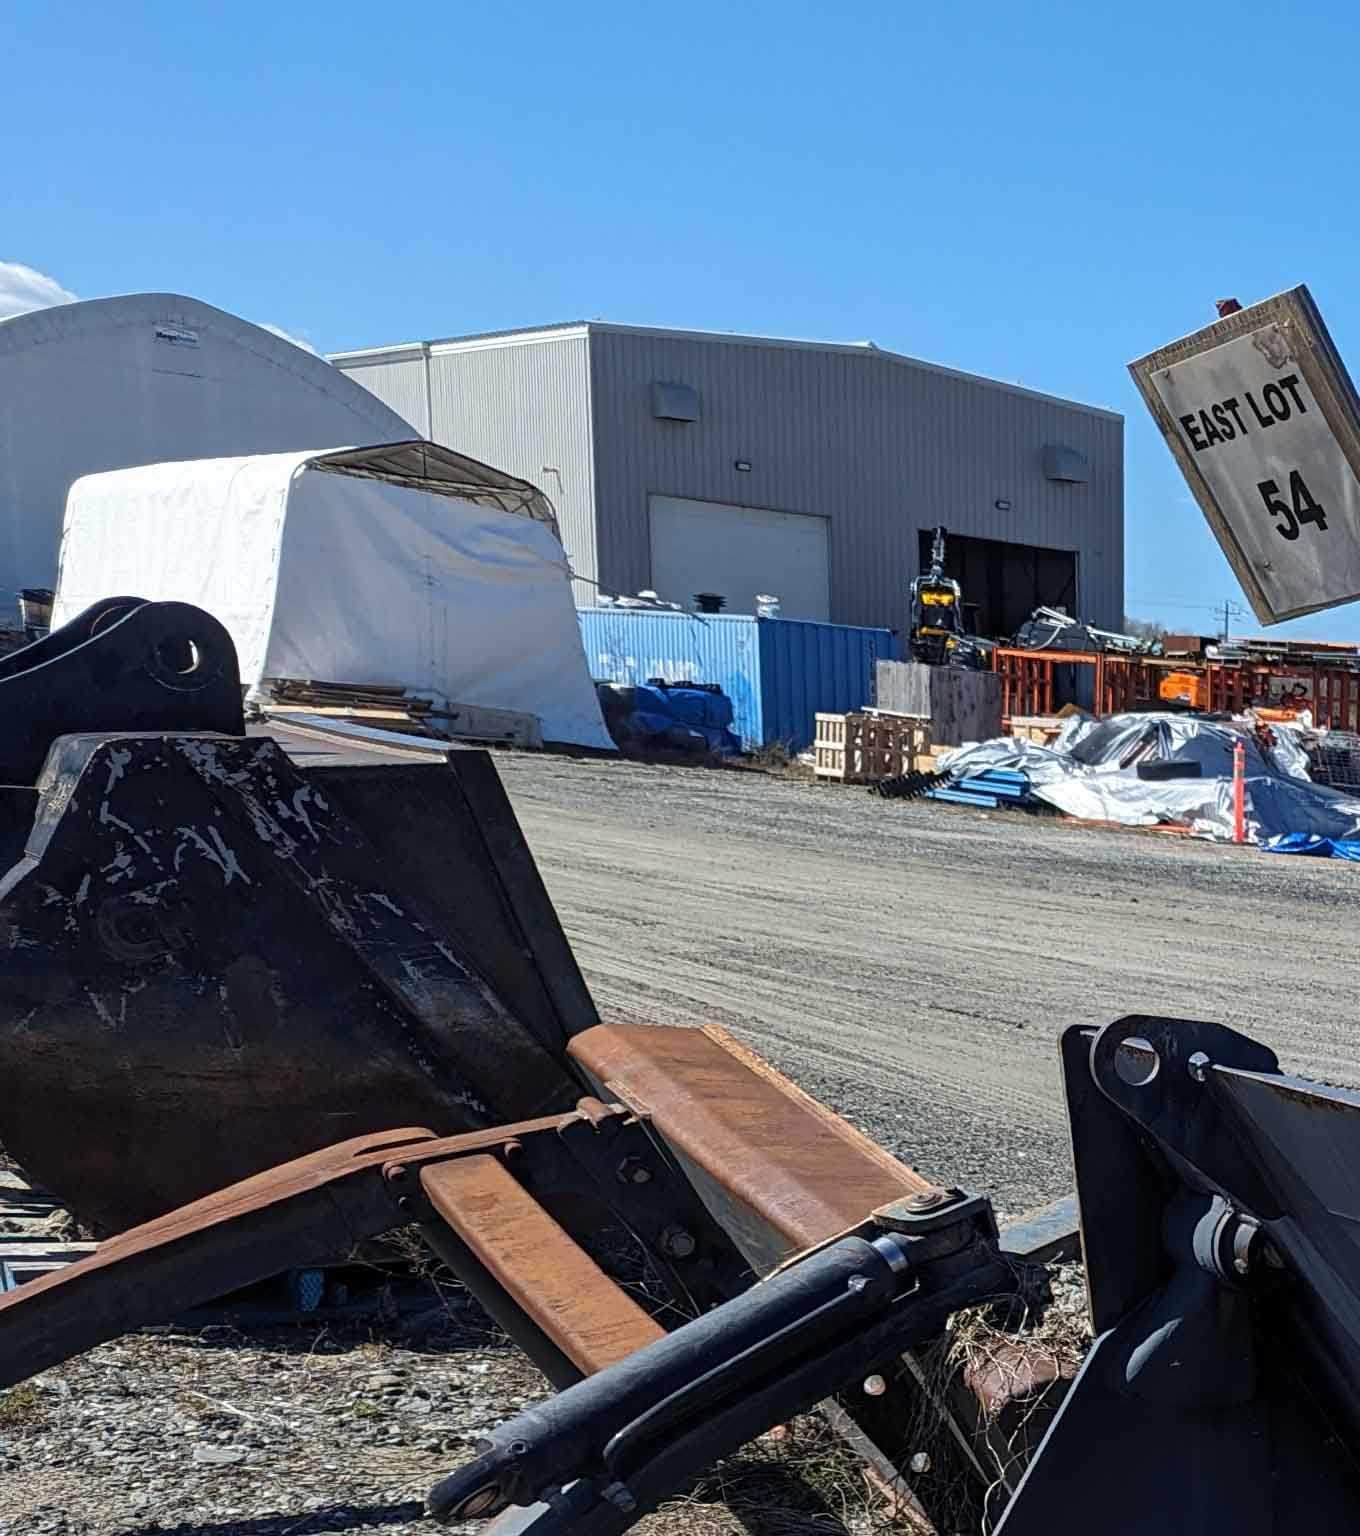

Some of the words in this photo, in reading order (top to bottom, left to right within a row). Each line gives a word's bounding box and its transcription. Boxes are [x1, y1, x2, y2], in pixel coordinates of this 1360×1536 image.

[1179, 398, 1249, 451] EAST
[1245, 374, 1307, 429] LOT
[1257, 470, 1329, 540] 54
